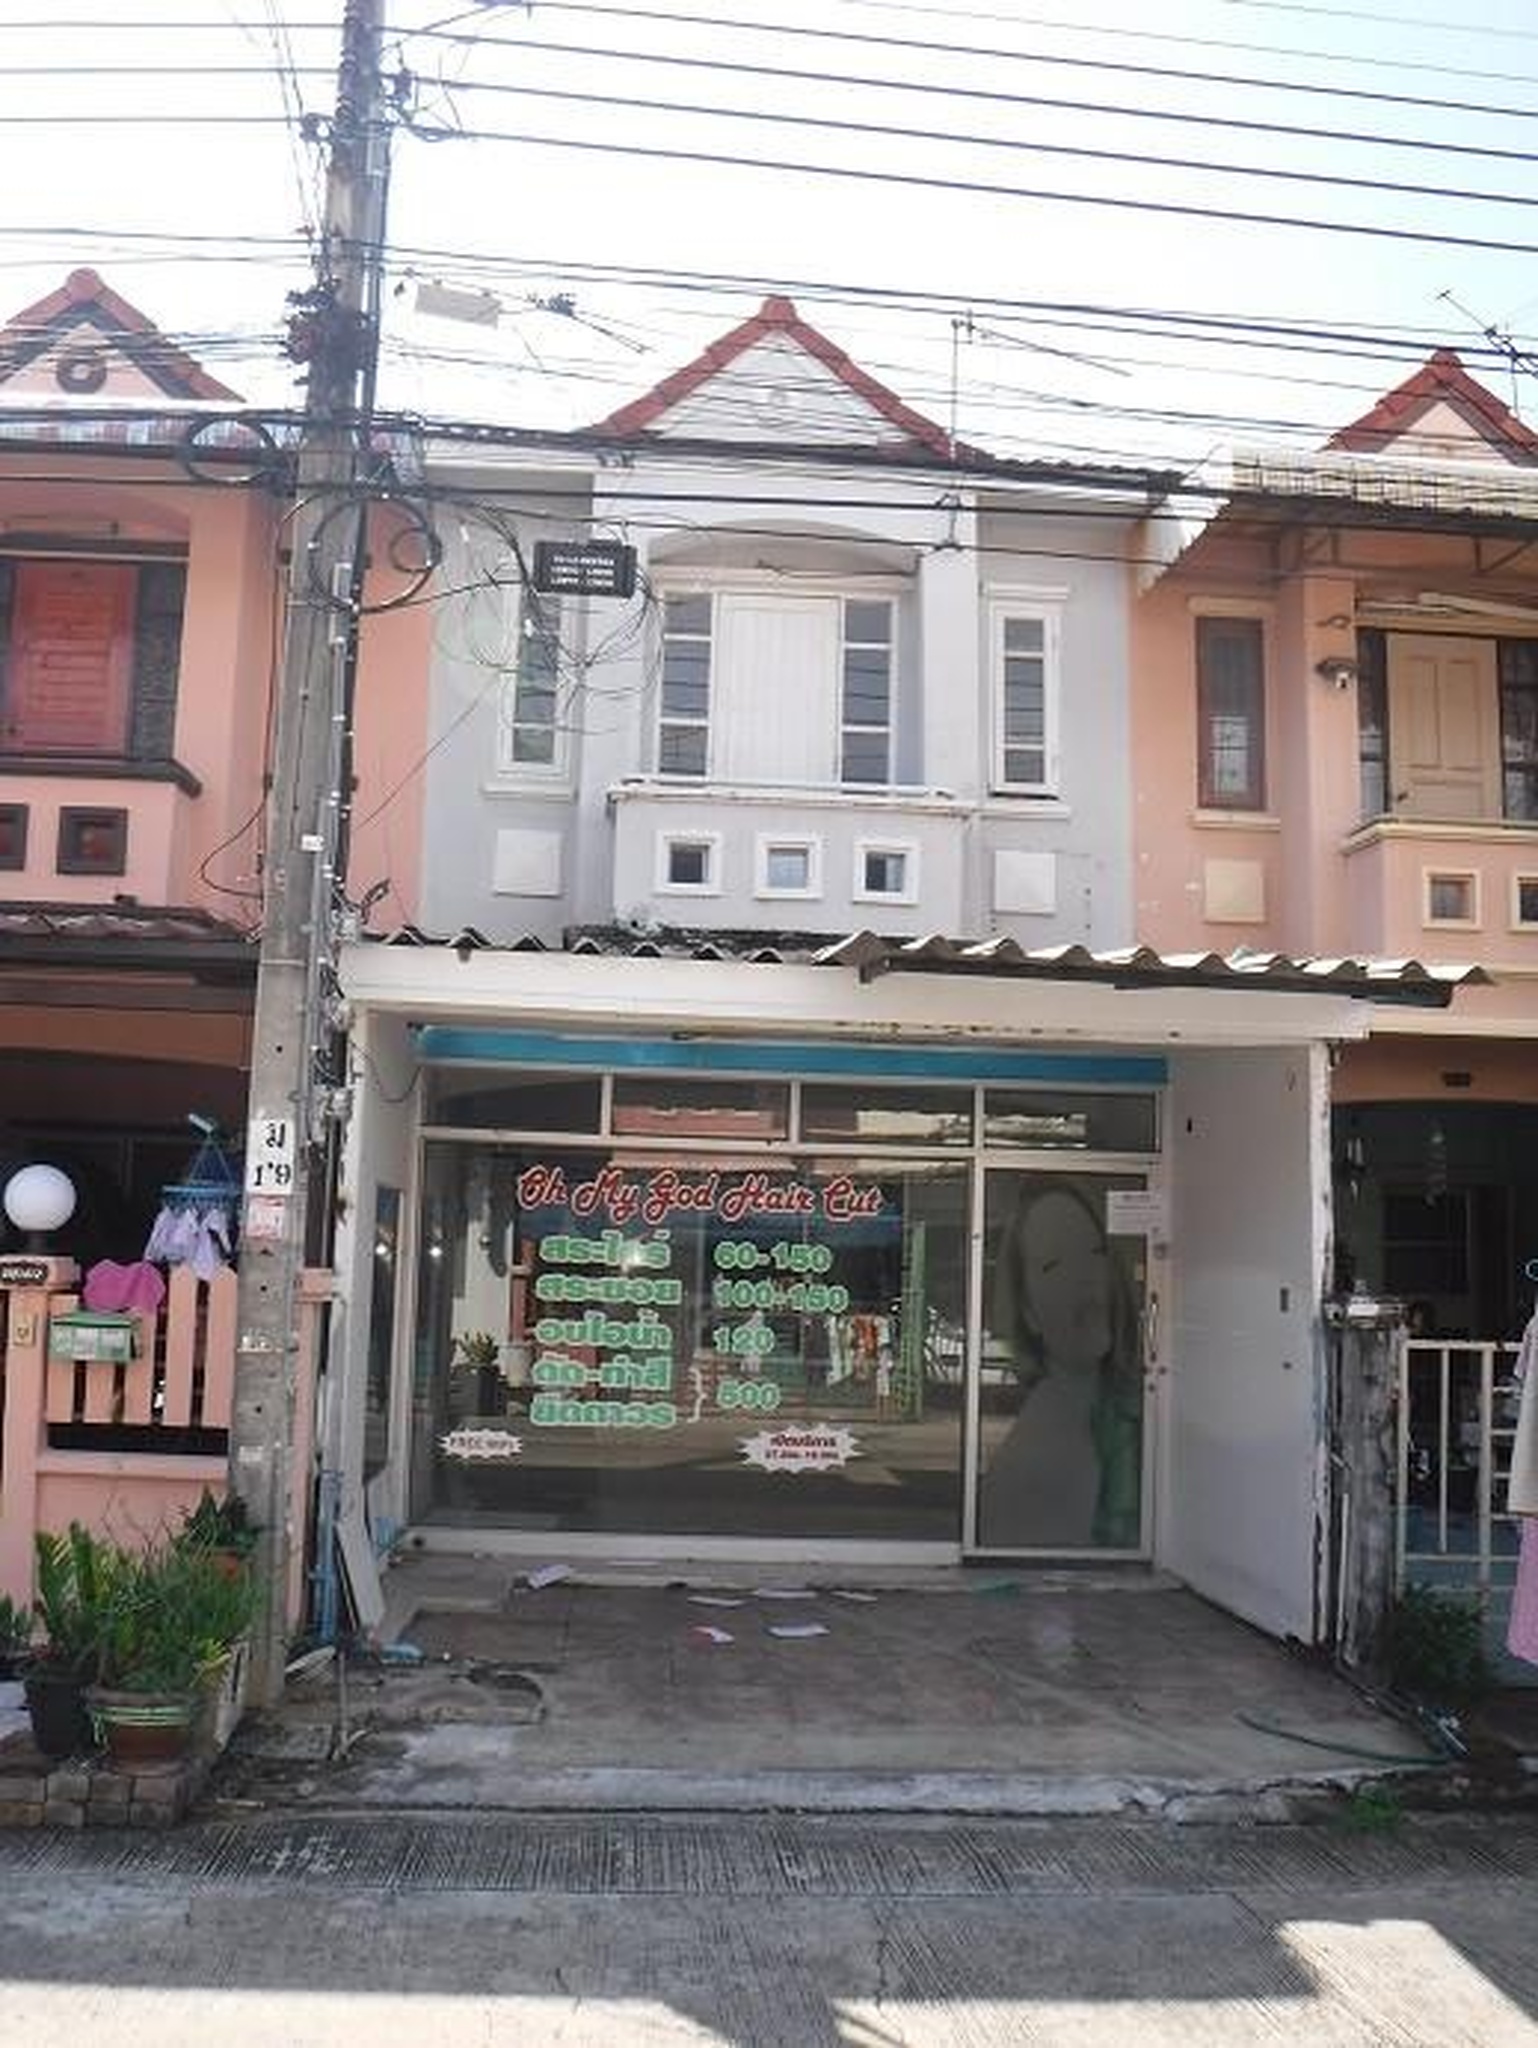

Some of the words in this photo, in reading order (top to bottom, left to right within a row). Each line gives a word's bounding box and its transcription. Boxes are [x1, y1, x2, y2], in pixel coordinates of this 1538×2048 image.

[518, 1165, 569, 1210] Oh
[571, 1169, 639, 1224] My
[643, 1170, 720, 1224] God
[719, 1173, 815, 1222] Hair
[822, 1177, 884, 1222] Cut
[713, 1241, 832, 1273] 60-150
[713, 1279, 849, 1313] 100-150
[713, 1326, 775, 1354] 120
[717, 1380, 780, 1410] 500
